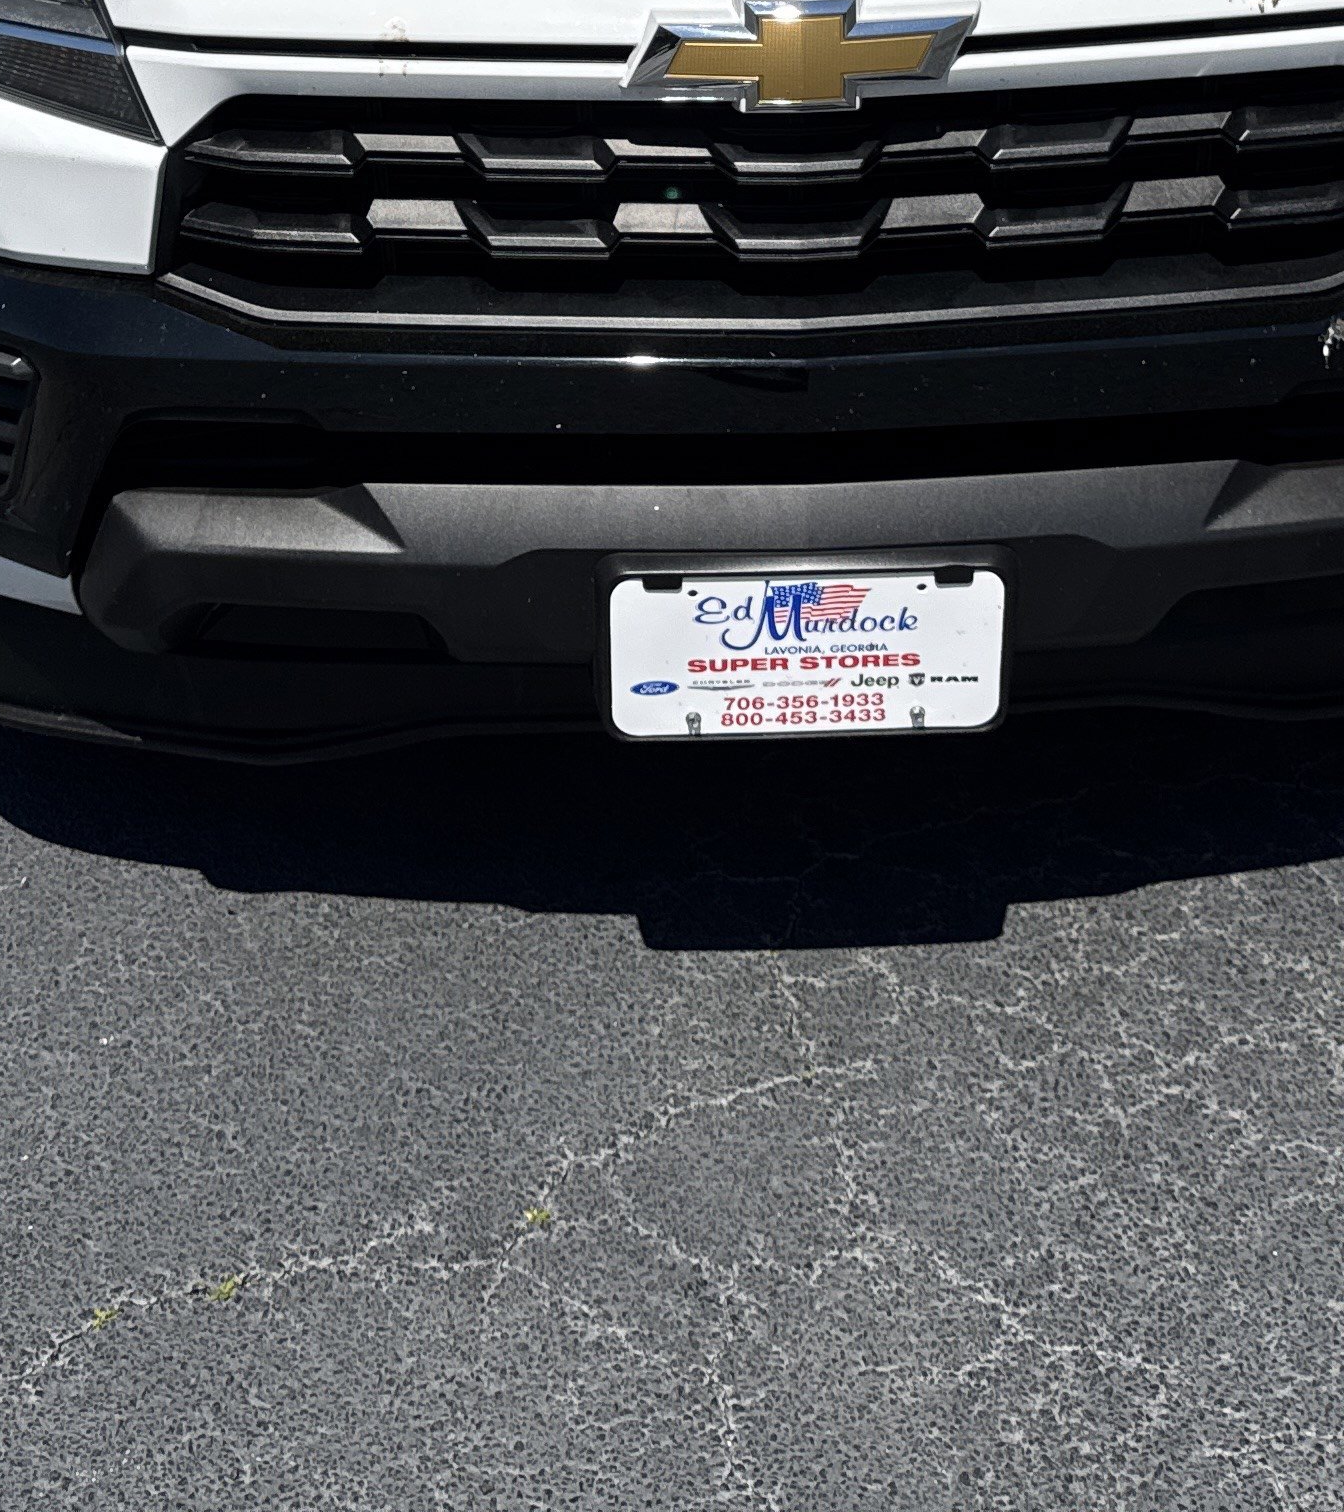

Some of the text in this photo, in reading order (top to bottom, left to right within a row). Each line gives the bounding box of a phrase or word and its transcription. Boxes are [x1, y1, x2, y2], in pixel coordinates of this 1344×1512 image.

[692, 579, 919, 651] Ed Murdock
[764, 643, 825, 656] LAVONIA,
[687, 652, 921, 673] SUPER STORES
[851, 673, 900, 689] Jeep
[931, 675, 978, 683] RAM
[723, 692, 884, 711] 706-356-1933
[720, 708, 886, 727] 800-453-3433
